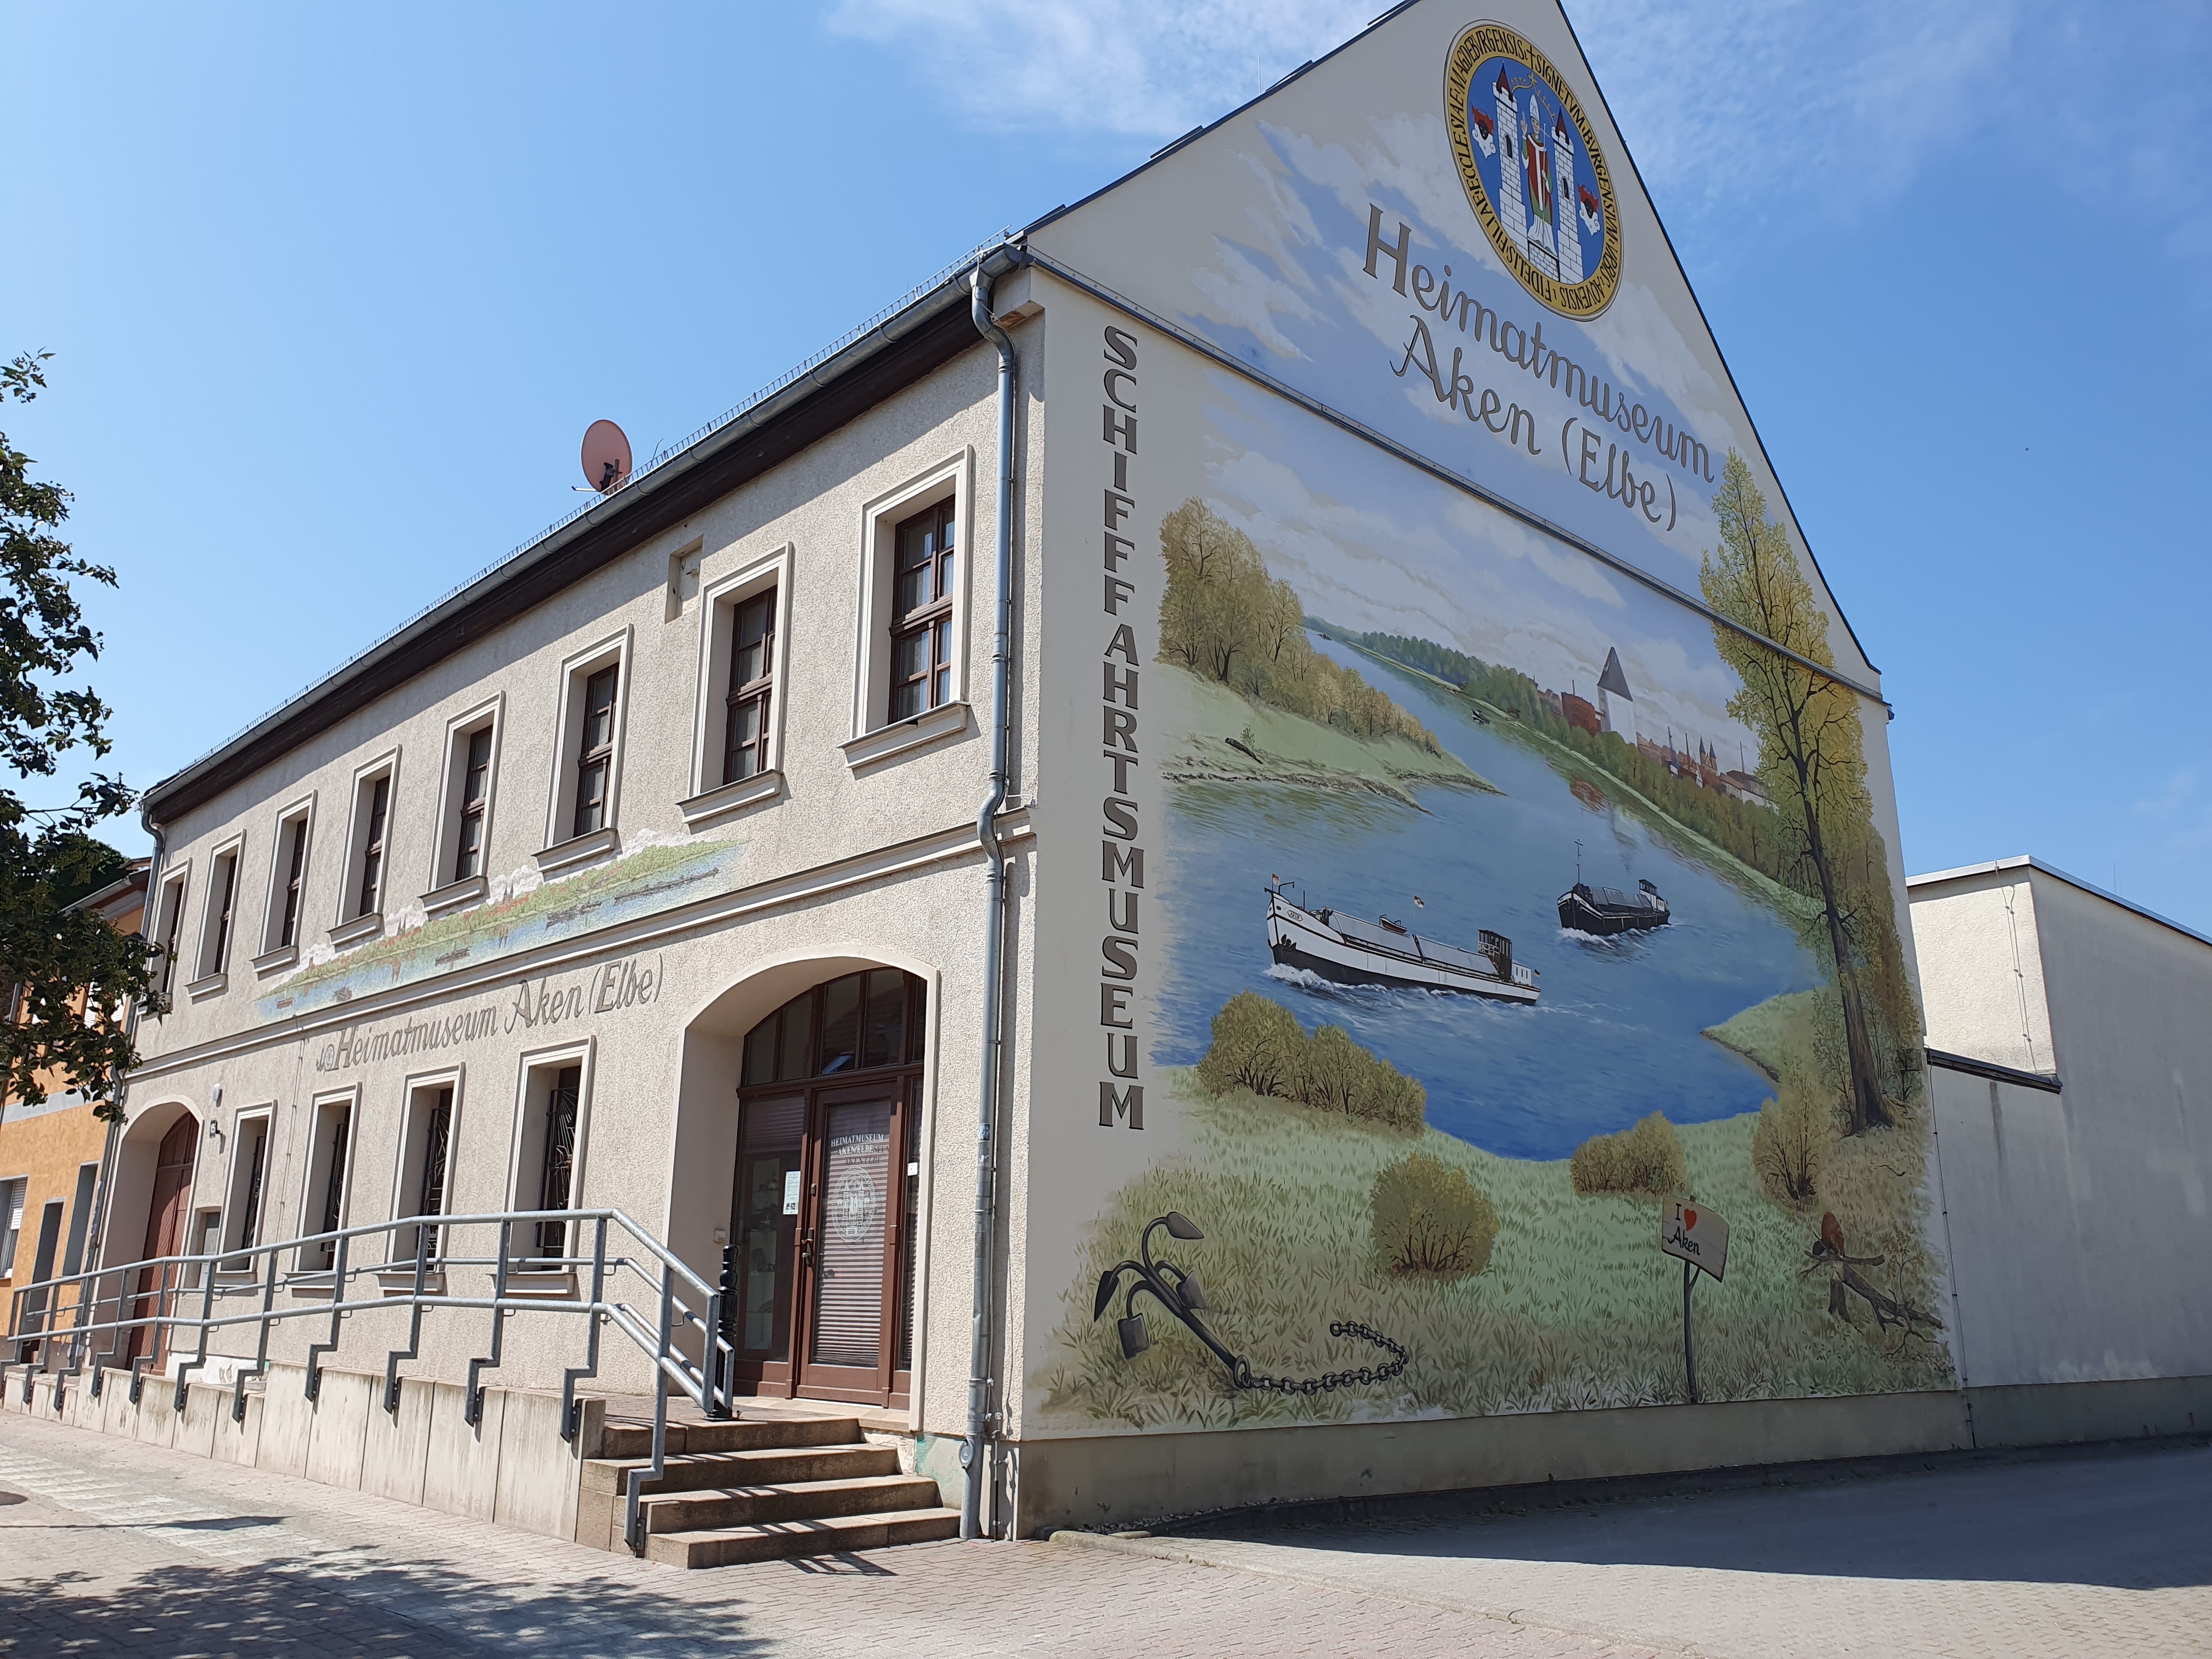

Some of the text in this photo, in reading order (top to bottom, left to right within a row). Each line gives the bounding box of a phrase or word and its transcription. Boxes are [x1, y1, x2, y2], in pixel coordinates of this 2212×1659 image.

[1534, 54, 1585, 128] SIGNETVM
[1450, 87, 1481, 191] ECCLESIAE
[1472, 191, 1508, 253] FILIAE
[1506, 246, 1552, 302] FIDELIS
[1362, 202, 1714, 483] Heimatmuseum
[1389, 314, 1676, 531] Aken (Elbe)
[1098, 325, 1145, 1130] SCHIFFFAHRTSMUSEUM
[330, 952, 664, 1070] Heimatmuseum Aken (Elbe)
[831, 1133, 884, 1148] HEIMATMUSEUM
[1667, 1226, 1700, 1256] Aken
[1675, 1203, 1681, 1221] I
